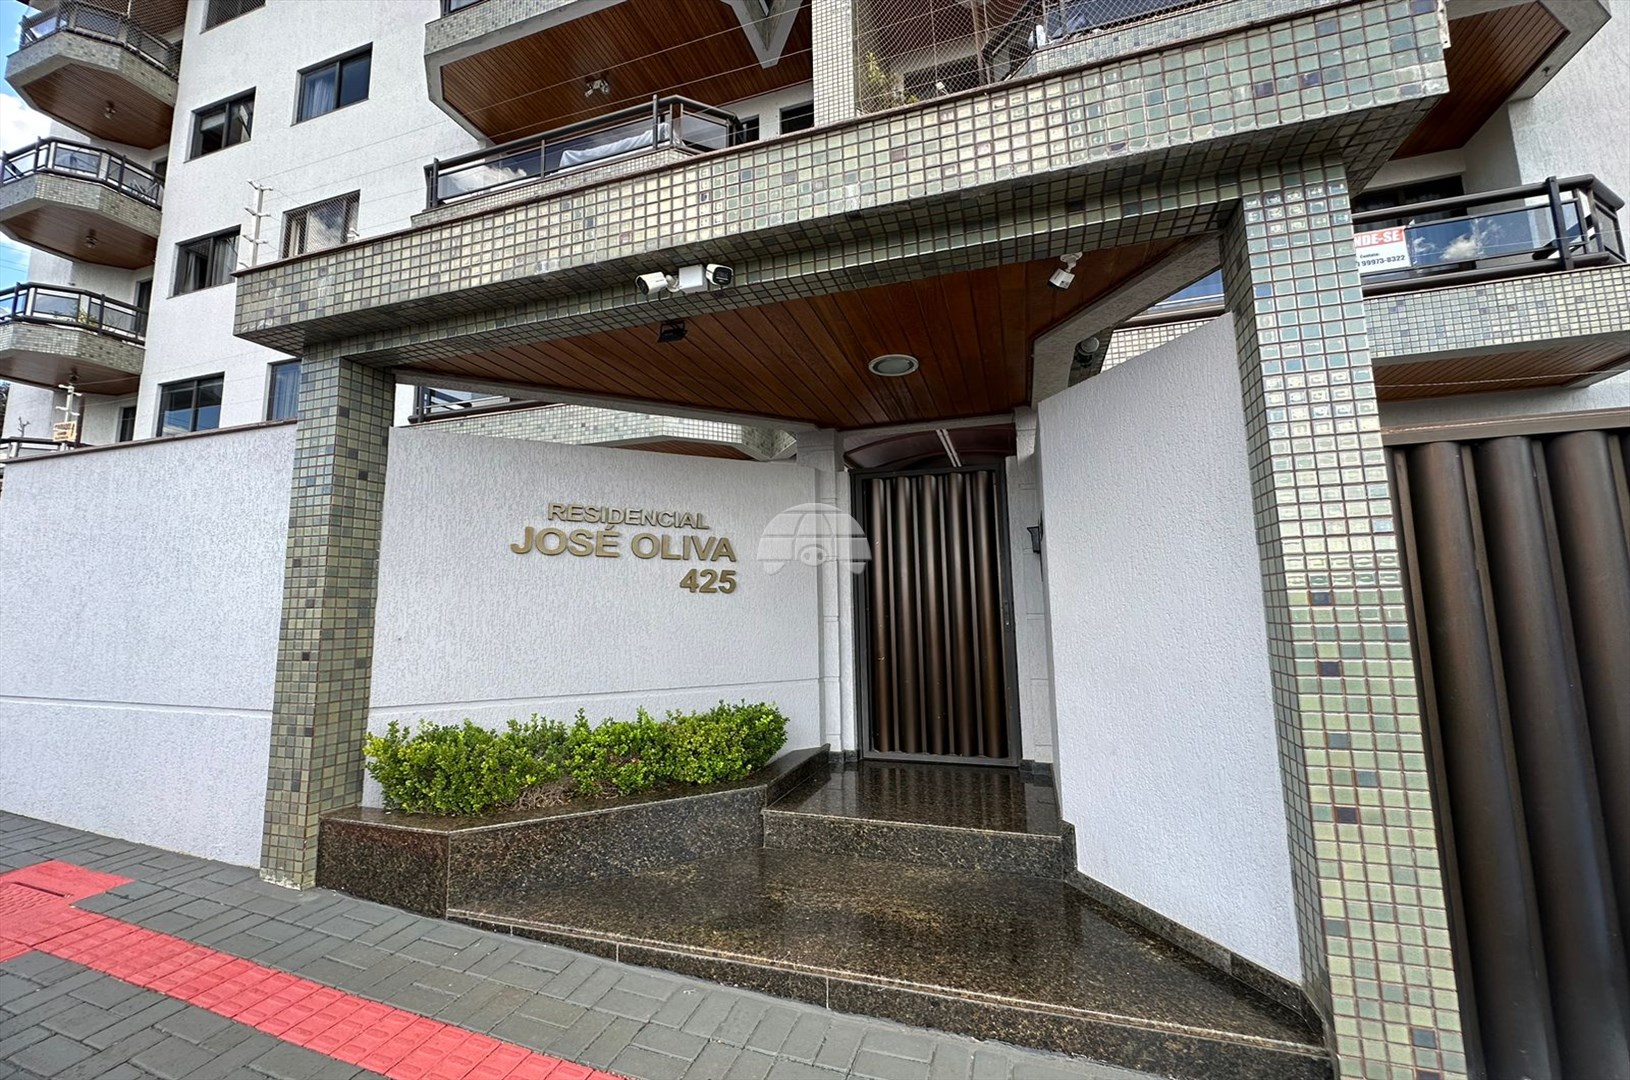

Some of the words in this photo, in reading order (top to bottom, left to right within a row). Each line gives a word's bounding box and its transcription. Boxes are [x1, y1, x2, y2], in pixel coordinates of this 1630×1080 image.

[1354, 229, 1400, 247] NDE-SE
[547, 502, 710, 530] RESIDENCIAL
[510, 525, 620, 558] JOSÉ
[630, 532, 737, 562] OLIVA
[679, 568, 737, 594] 425
